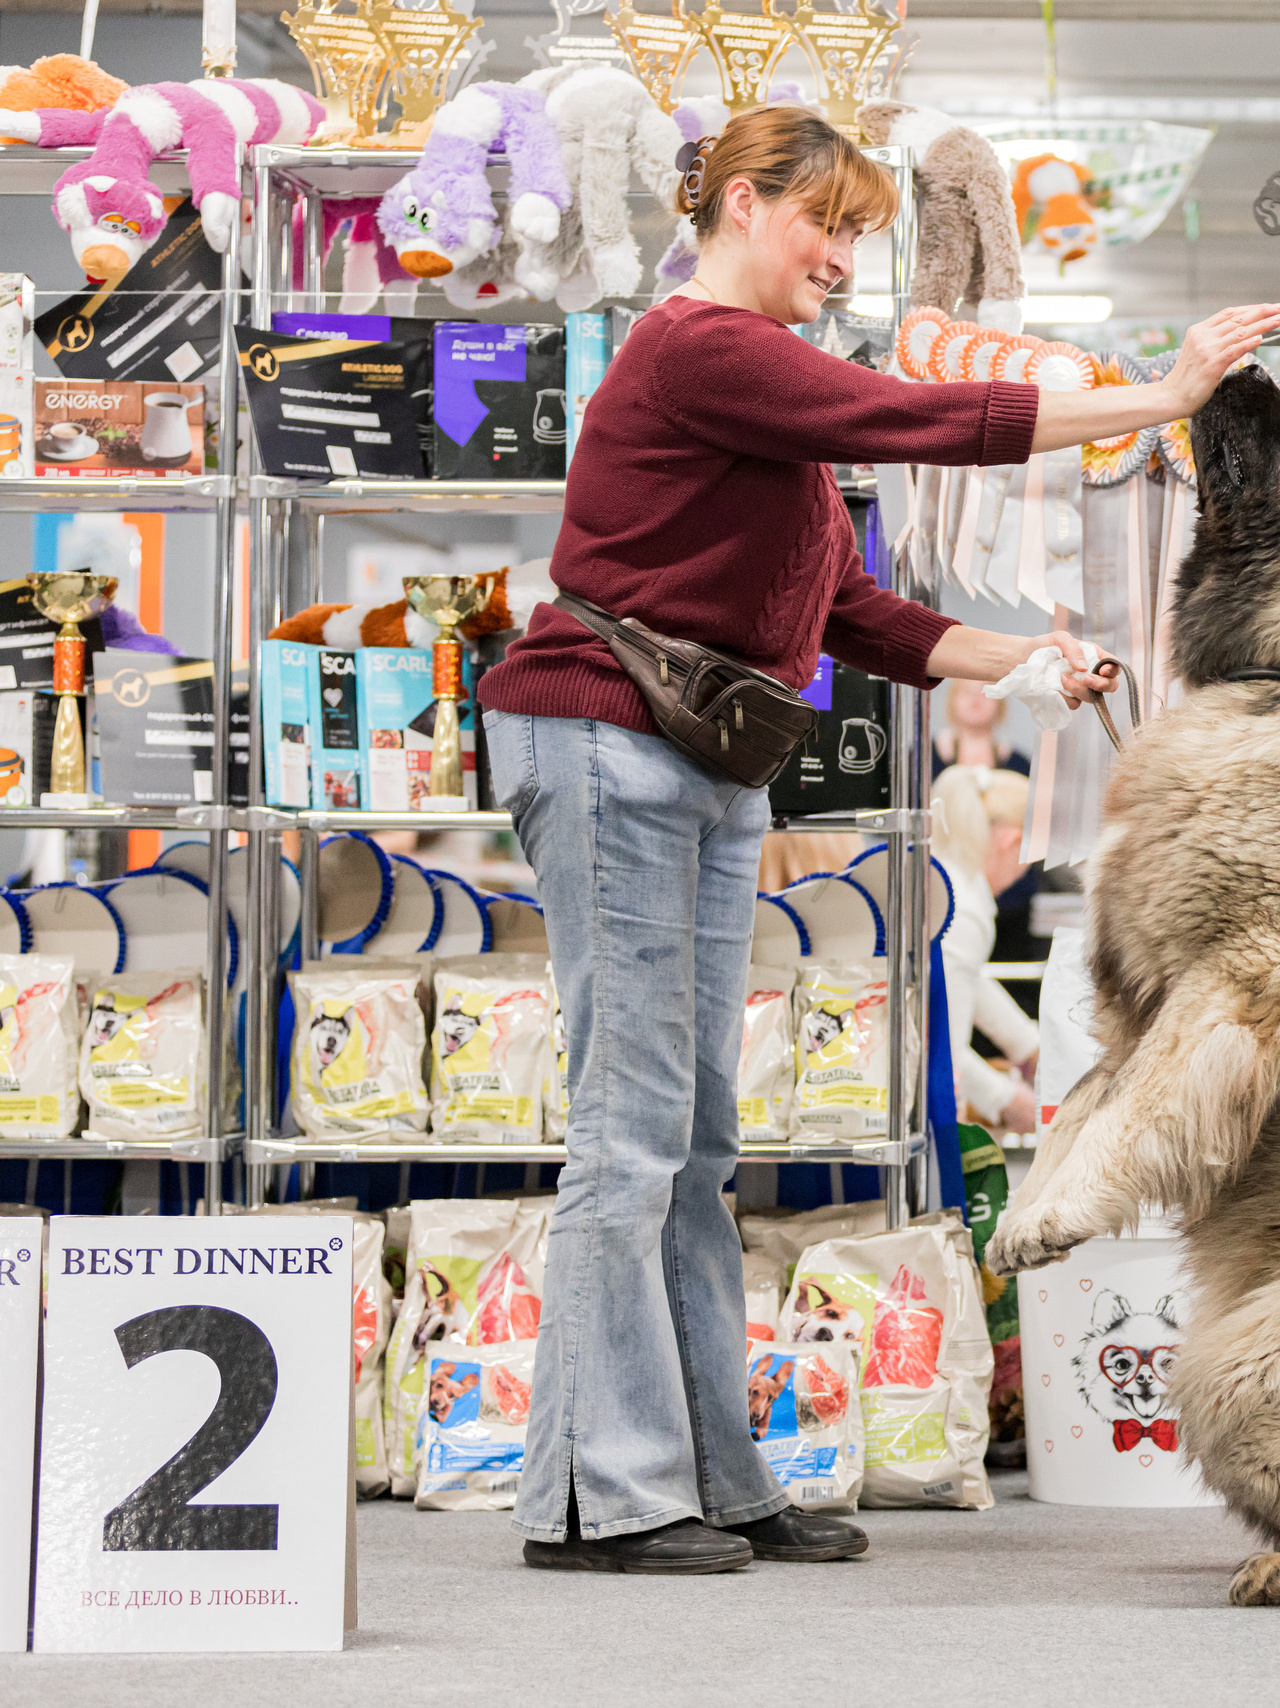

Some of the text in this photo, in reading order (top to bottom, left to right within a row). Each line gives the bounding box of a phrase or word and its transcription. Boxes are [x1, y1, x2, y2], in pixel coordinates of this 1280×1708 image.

[452, 340, 516, 351] Души в вас
[451, 353, 467, 361] не
[61, 1247, 333, 1275] BEST DINNER
[103, 1304, 280, 1551] 2
[81, 1590, 120, 1607] ВСЕ
[124, 1590, 183, 1610] ДЕЛО
[190, 1590, 202, 1606] В
